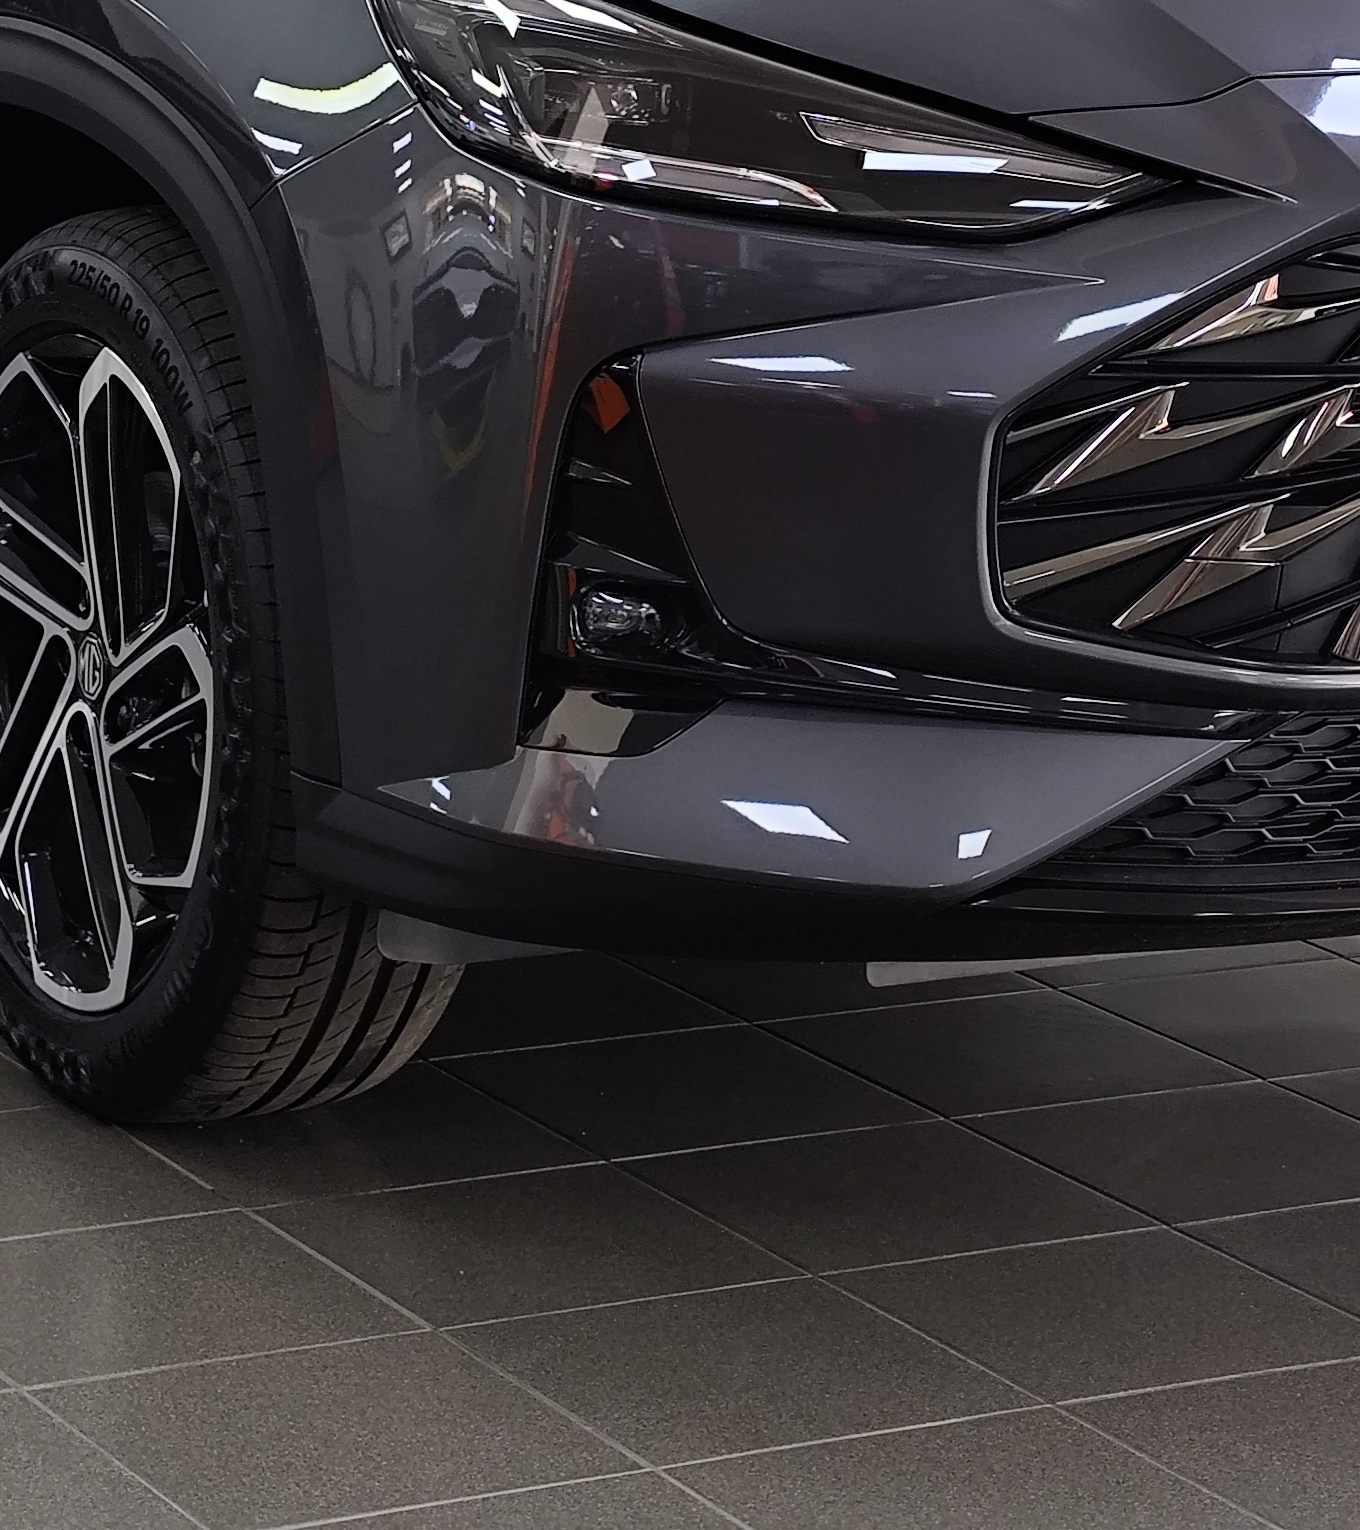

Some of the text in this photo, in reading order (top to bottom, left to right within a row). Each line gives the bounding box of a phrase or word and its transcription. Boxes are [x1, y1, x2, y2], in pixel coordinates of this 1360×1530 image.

[67, 259, 194, 416] 225/50 R 19 100W
